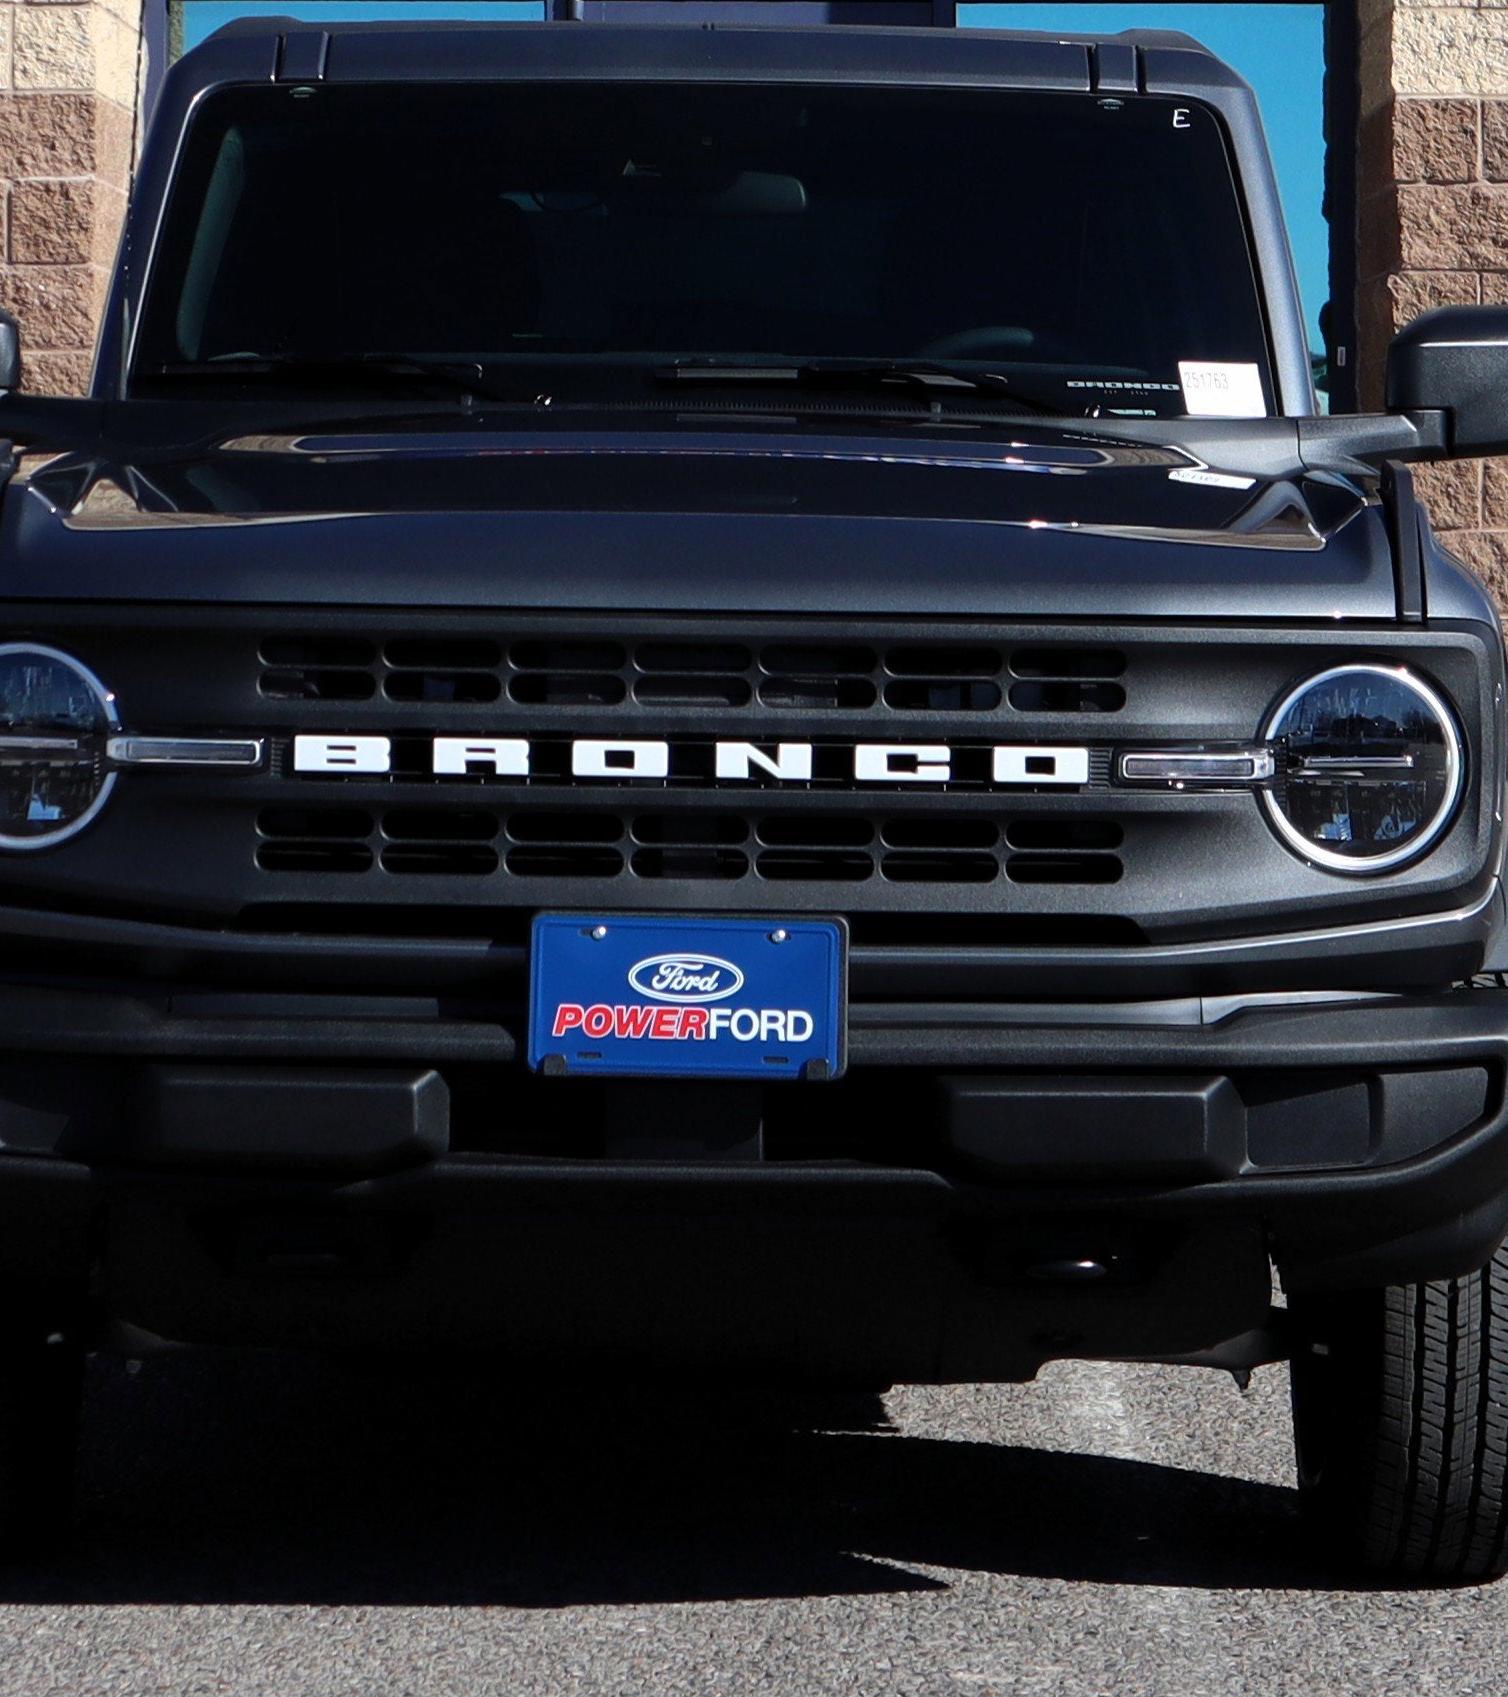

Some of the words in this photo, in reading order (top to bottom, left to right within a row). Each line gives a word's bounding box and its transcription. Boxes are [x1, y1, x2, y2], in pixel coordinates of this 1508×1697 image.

[1173, 108, 1191, 128] E
[1184, 372, 1229, 390] 251763
[293, 734, 1090, 784] BRONCO
[652, 962, 720, 992] Ford
